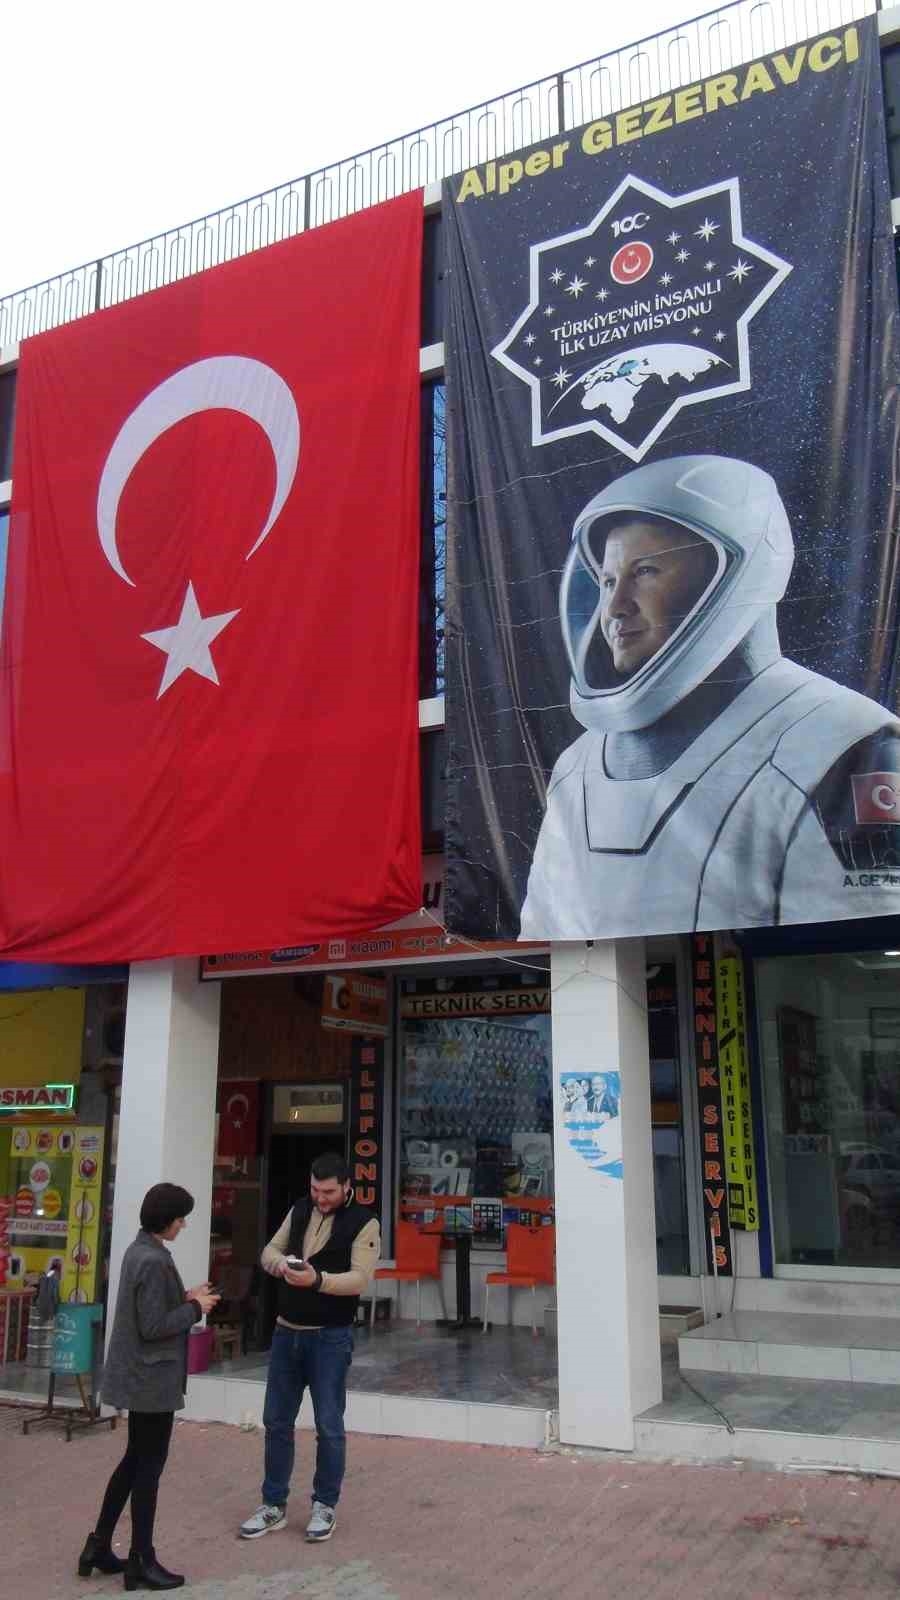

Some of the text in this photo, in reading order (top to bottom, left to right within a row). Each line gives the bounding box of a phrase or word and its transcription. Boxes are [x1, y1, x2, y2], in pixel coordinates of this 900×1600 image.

[456, 28, 859, 202] Alper GEZERAVCI
[655, 279, 721, 311] İNSANLI
[560, 299, 713, 357] İLK UZAY MİSYONU
[408, 993, 486, 1014] TEKNİK
[0, 1088, 68, 1106] SMAN
[730, 1146, 738, 1174] EL
[704, 1105, 727, 1266] SERVİS
